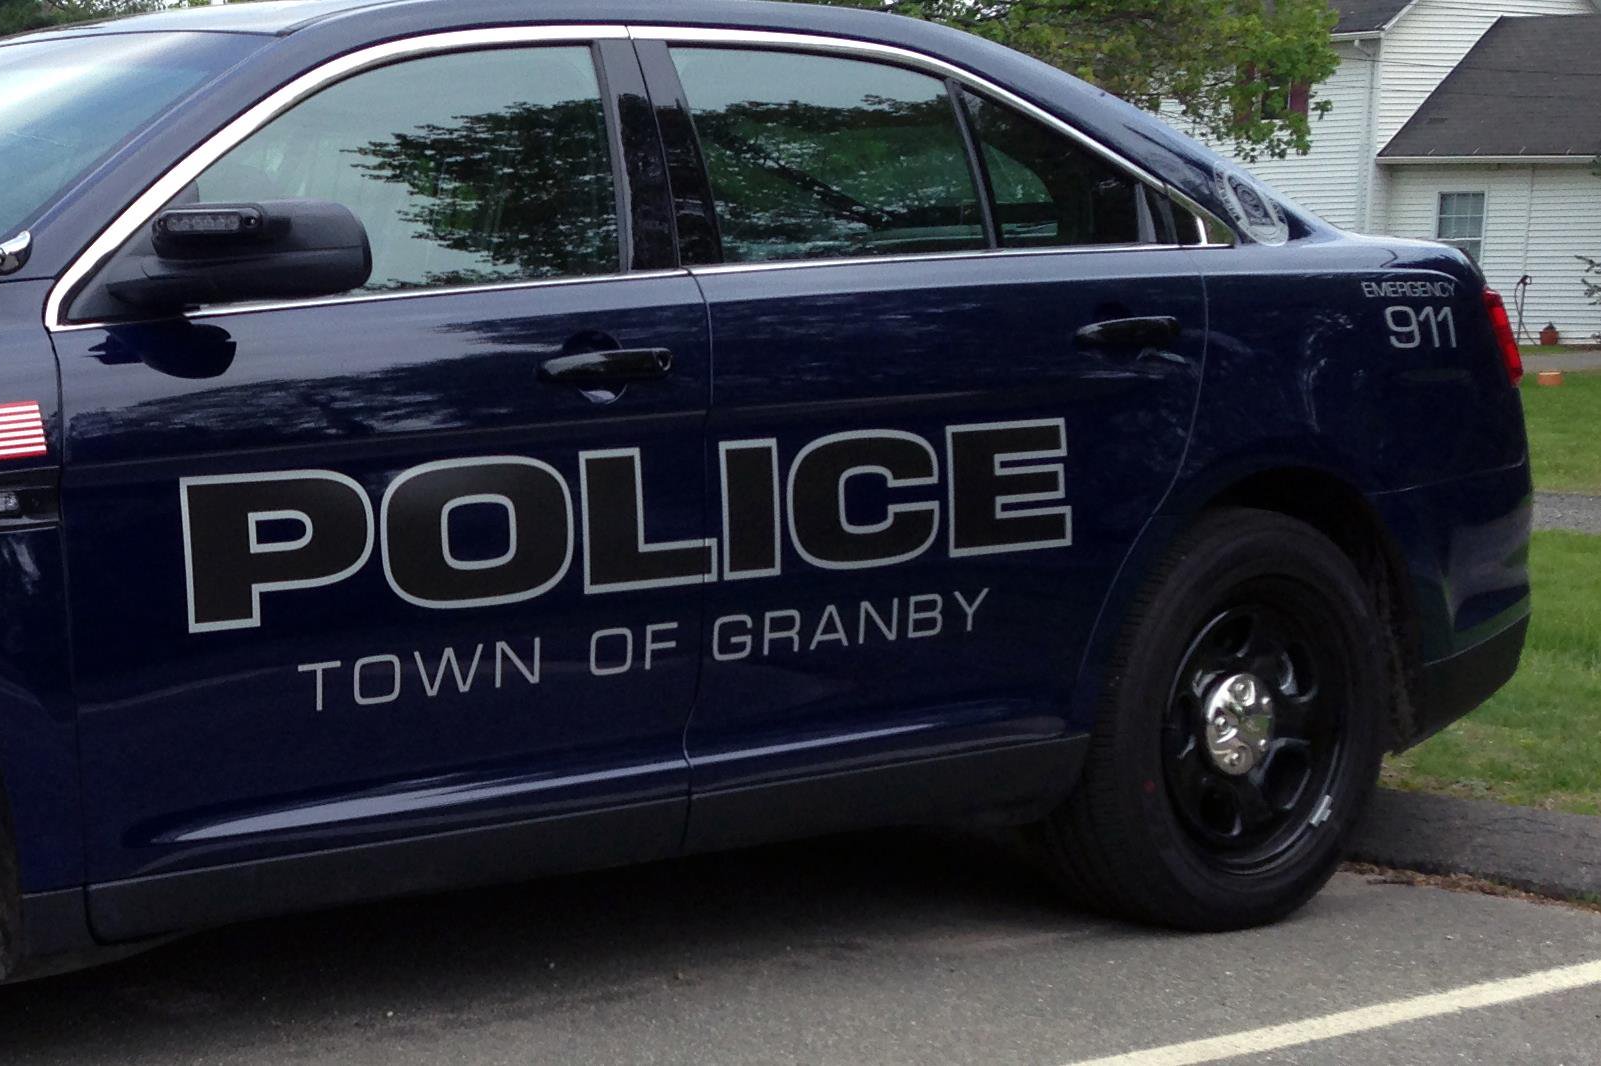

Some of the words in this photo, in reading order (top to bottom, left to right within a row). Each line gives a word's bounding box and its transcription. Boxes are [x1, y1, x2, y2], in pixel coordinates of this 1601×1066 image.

[1361, 281, 1455, 297] EMERGENCY
[1384, 305, 1457, 348] 911
[180, 417, 1073, 633] POLICE
[297, 636, 541, 711] TOWN
[589, 622, 679, 676] OF
[712, 588, 990, 662] GRANBY
